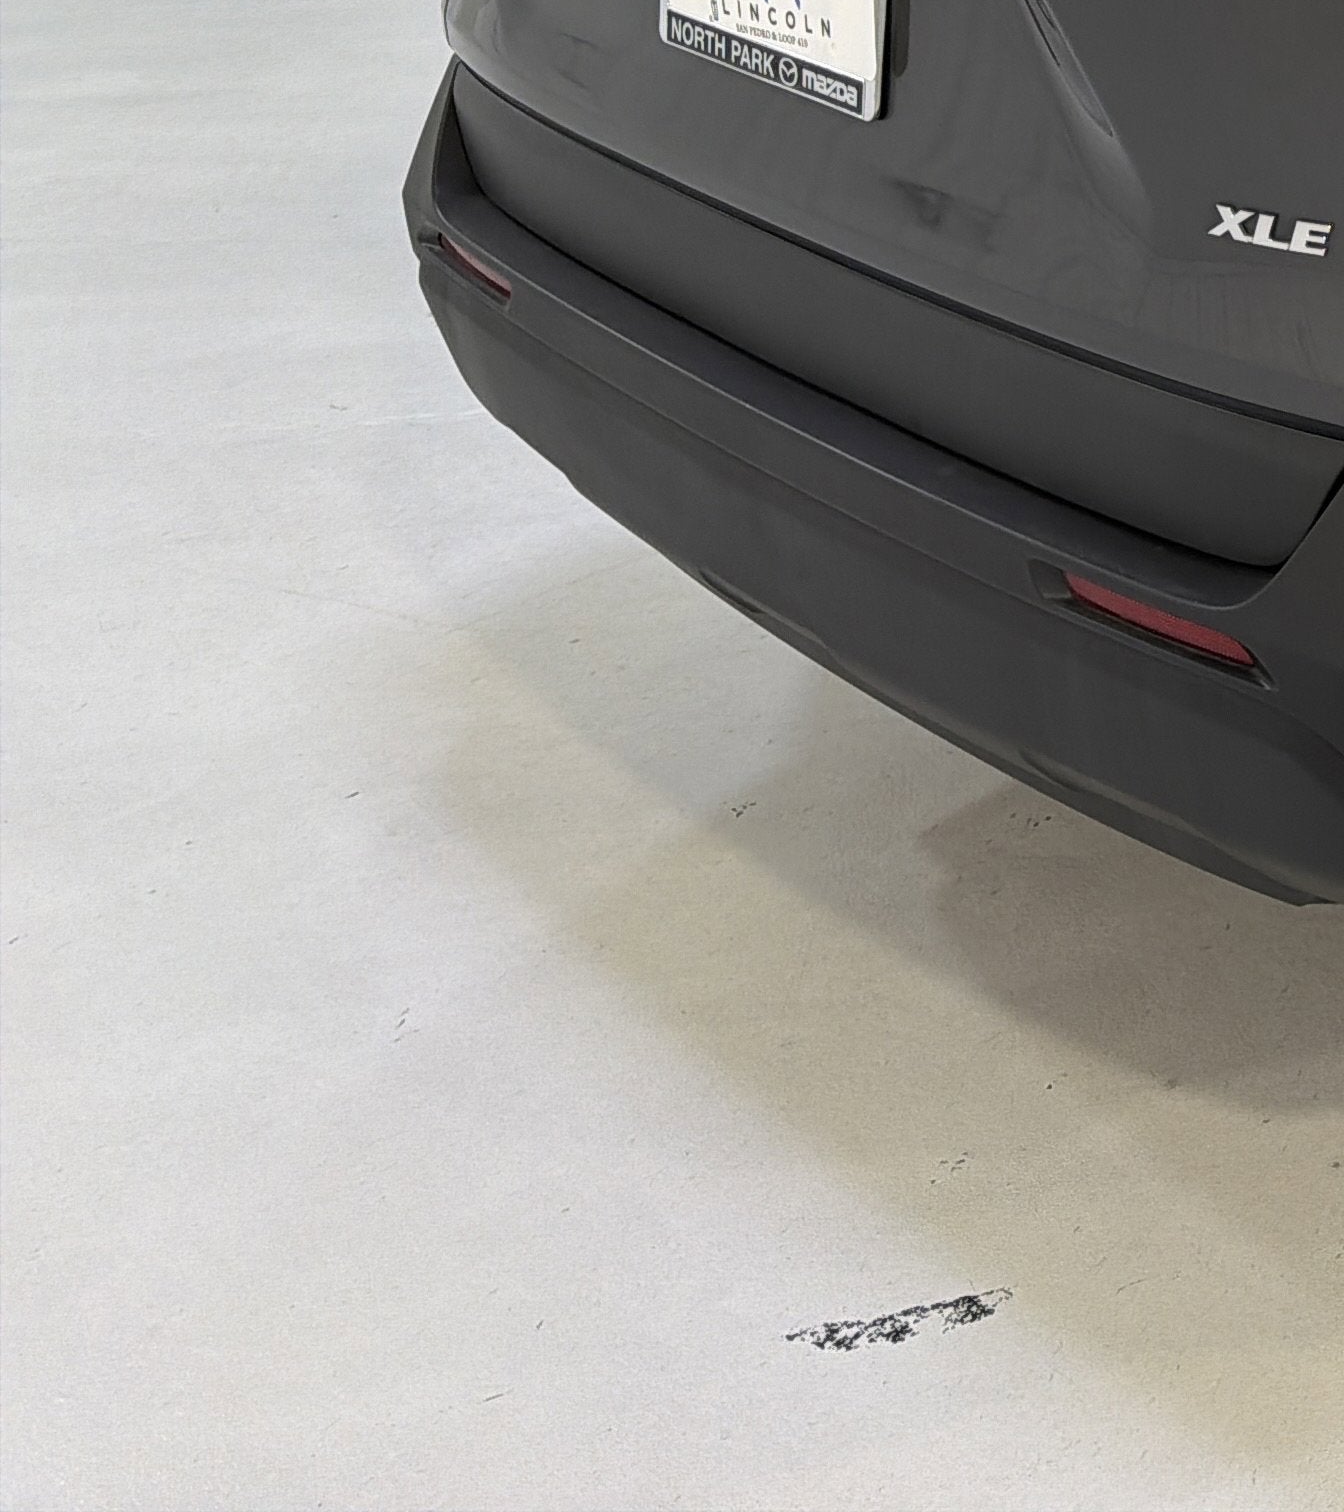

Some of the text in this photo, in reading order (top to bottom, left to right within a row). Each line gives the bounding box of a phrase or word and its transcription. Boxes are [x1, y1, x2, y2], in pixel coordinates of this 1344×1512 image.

[671, 16, 858, 108] NORTH PARK mazda
[1207, 204, 1333, 256] XLE
